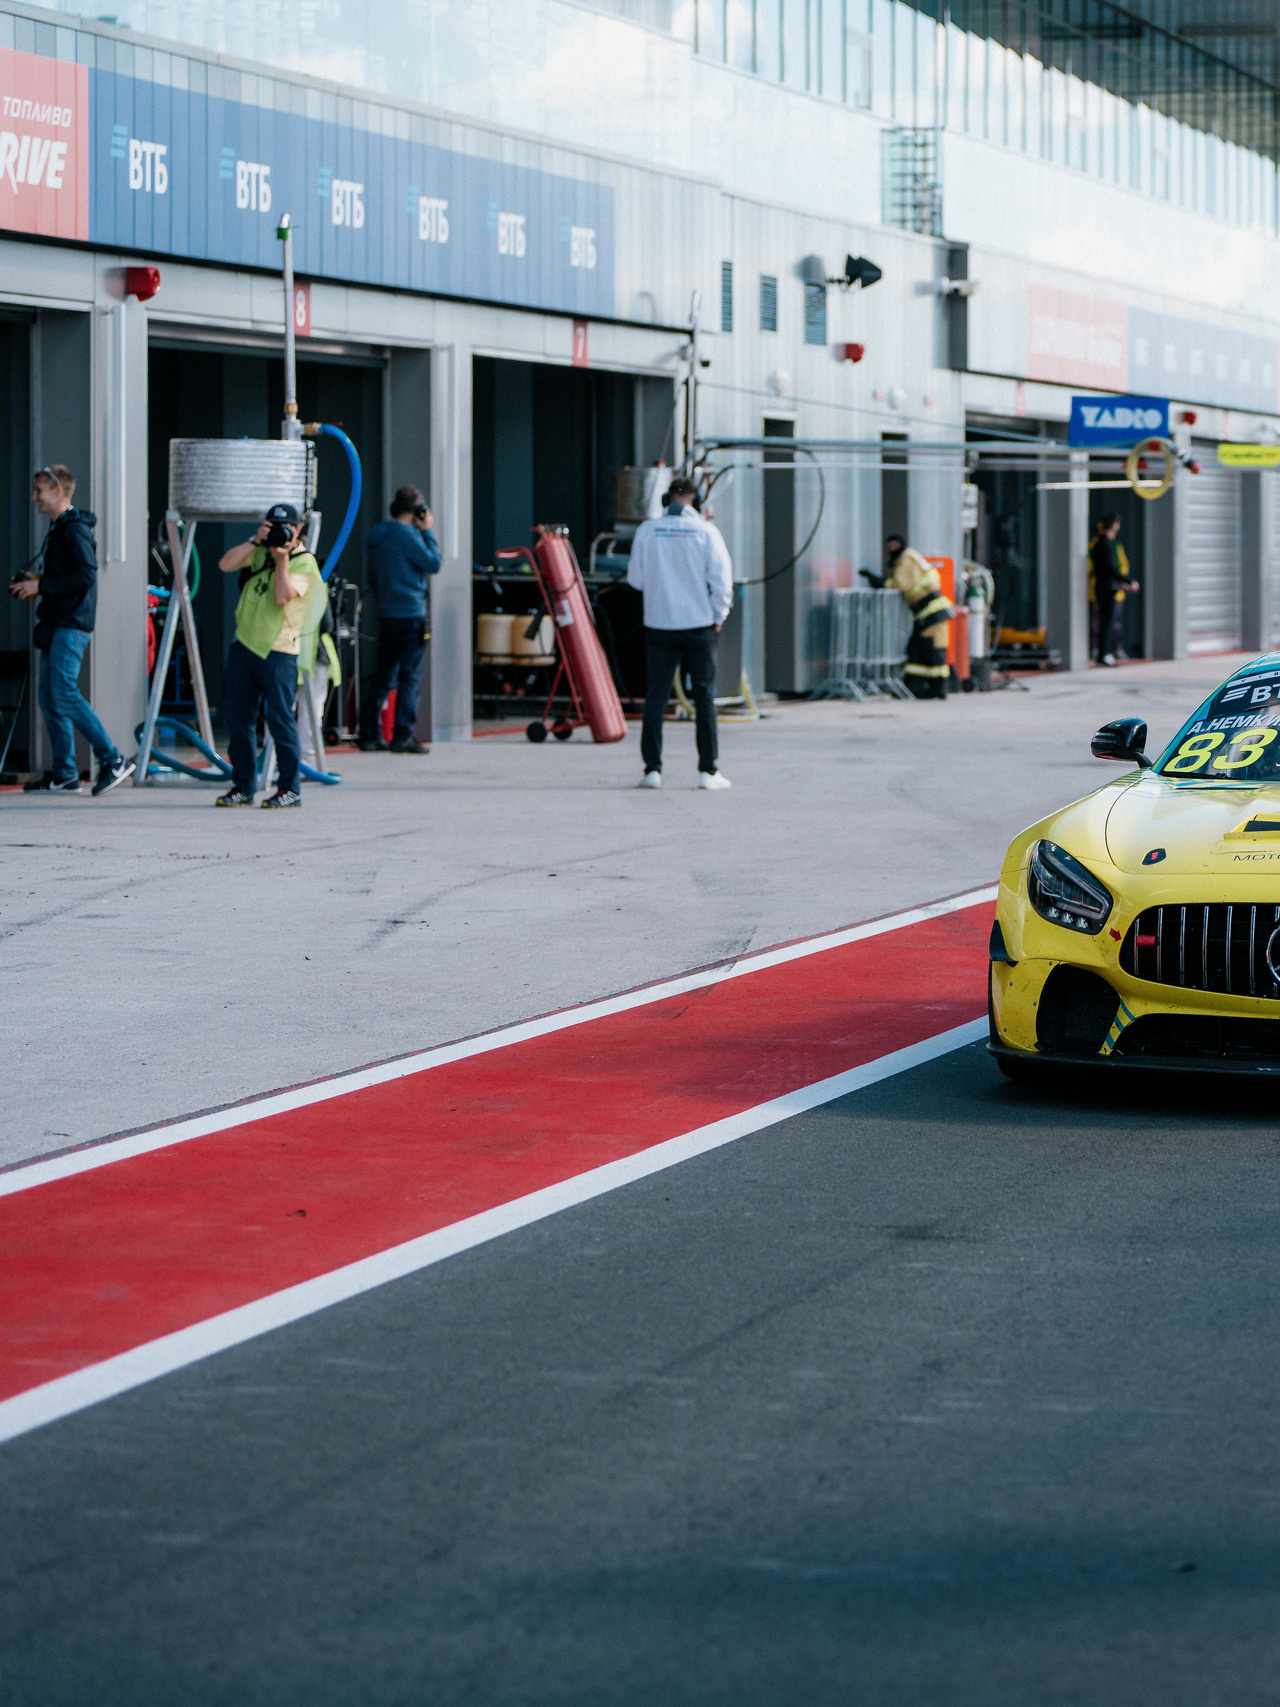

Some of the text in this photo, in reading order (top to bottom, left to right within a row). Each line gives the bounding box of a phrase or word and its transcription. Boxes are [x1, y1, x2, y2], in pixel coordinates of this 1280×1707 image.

[3, 96, 72, 128] ТОПЛИВО
[128, 139, 168, 195] ВТБ
[235, 159, 271, 213] ВТБ
[332, 180, 364, 229] ВТБ
[418, 195, 449, 244] ВТБ
[498, 211, 526, 257] ВТБ
[570, 226, 597, 270] ВТБ
[296, 289, 306, 328] 8
[577, 327, 585, 359] 7
[1163, 728, 1278, 773] 83
